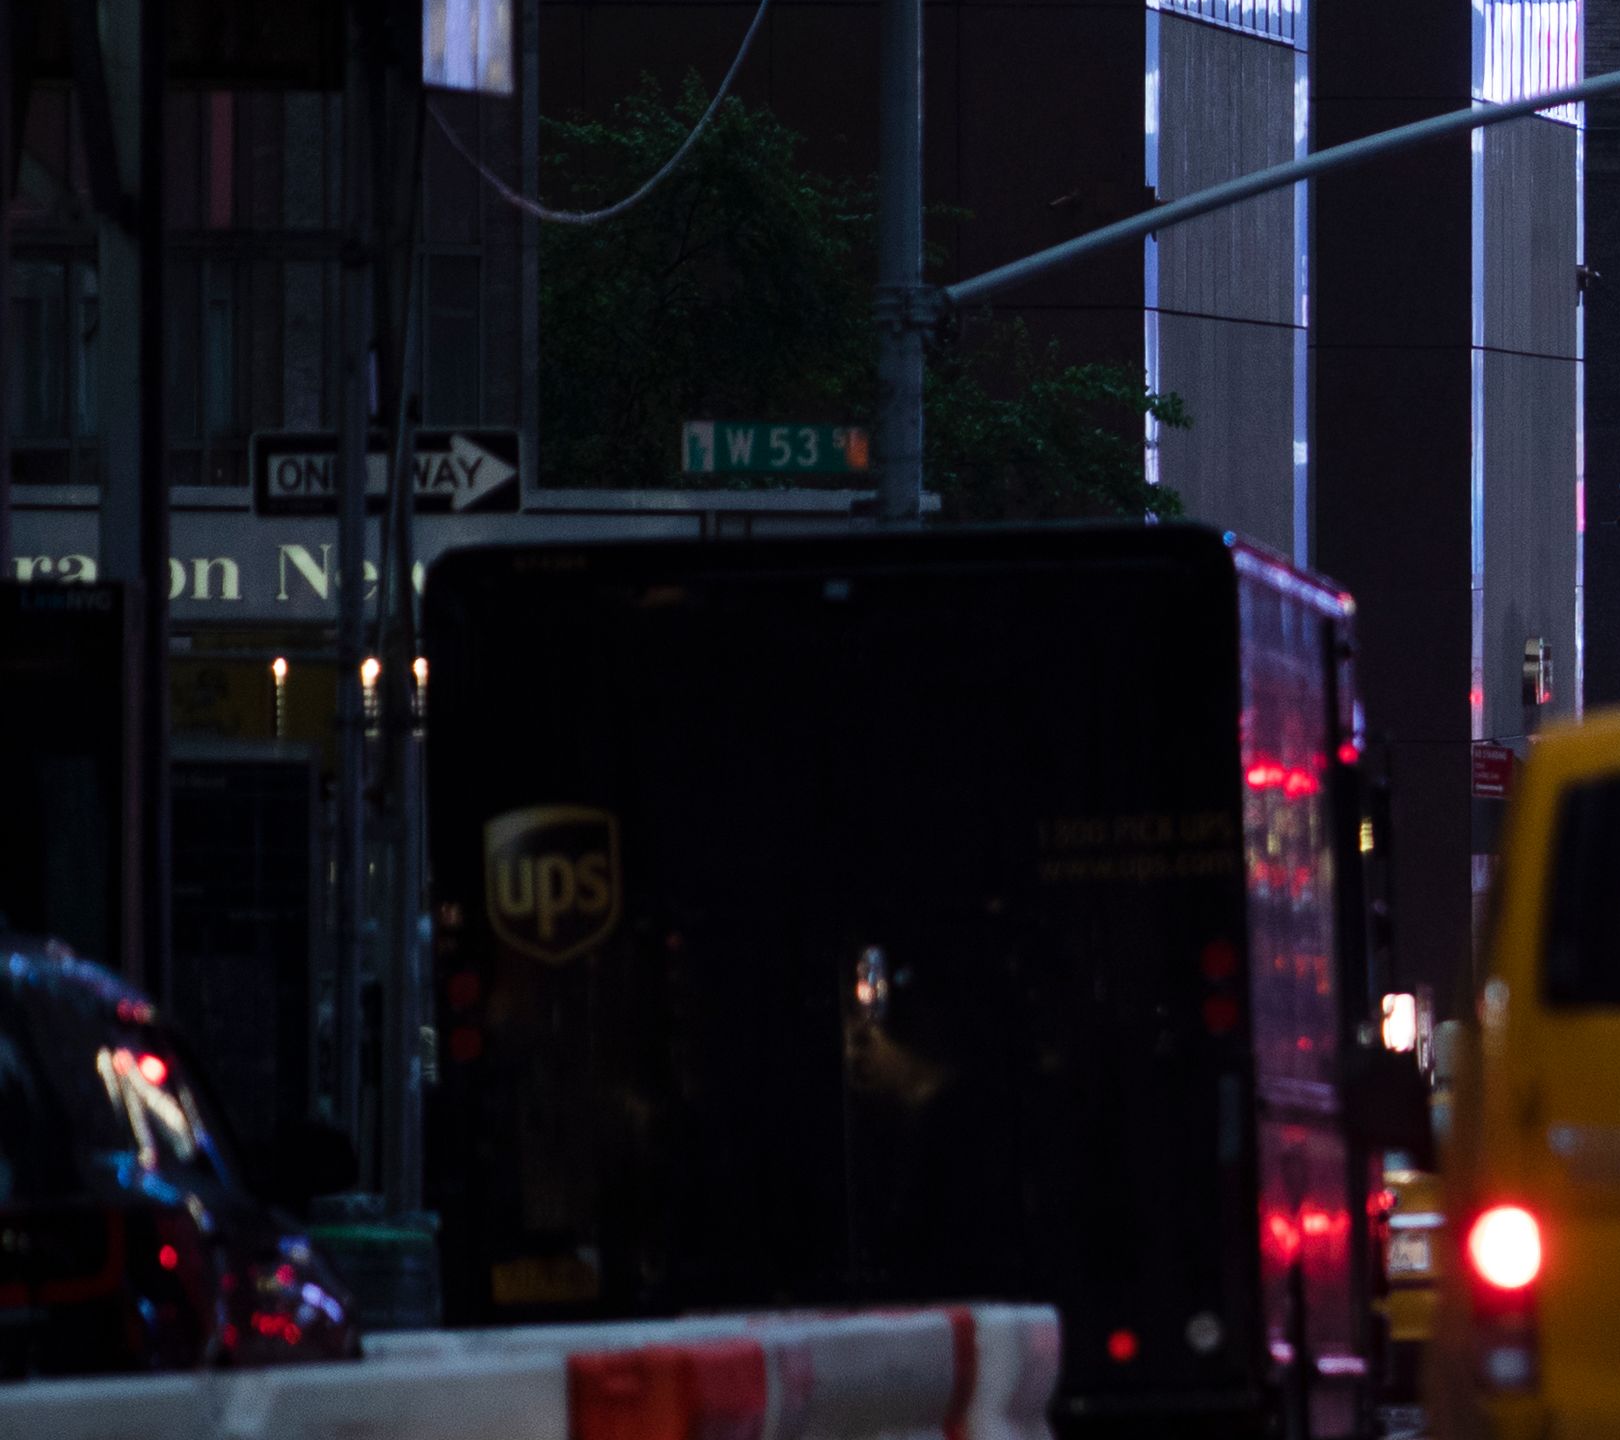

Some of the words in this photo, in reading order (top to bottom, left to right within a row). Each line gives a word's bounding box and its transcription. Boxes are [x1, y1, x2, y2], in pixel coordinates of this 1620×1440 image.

[727, 429, 755, 466] W
[769, 428, 818, 466] 53
[277, 459, 338, 492] ON
[500, 854, 609, 940] ups
